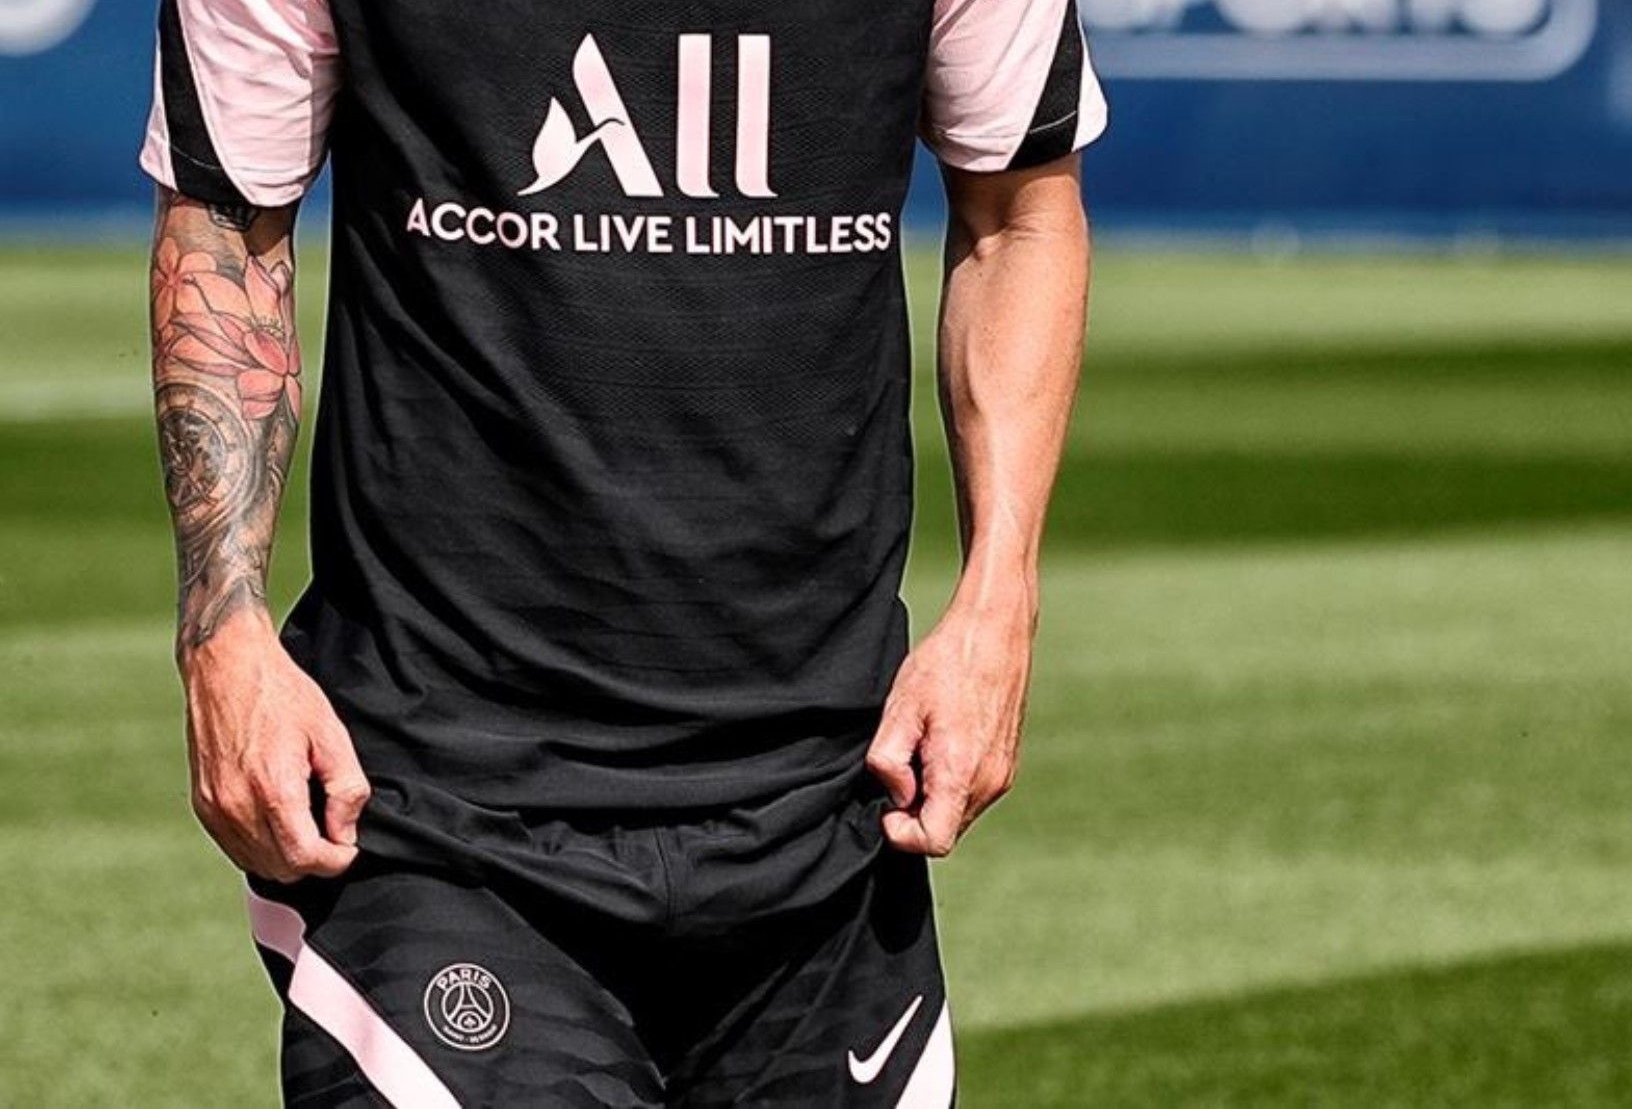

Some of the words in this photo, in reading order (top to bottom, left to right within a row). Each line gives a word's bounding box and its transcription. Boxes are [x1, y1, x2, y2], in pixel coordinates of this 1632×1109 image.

[406, 197, 561, 249] ACCOR
[573, 214, 672, 253] LIVE
[686, 212, 891, 254] LIMITLESS
[436, 968, 492, 990] PARIS
